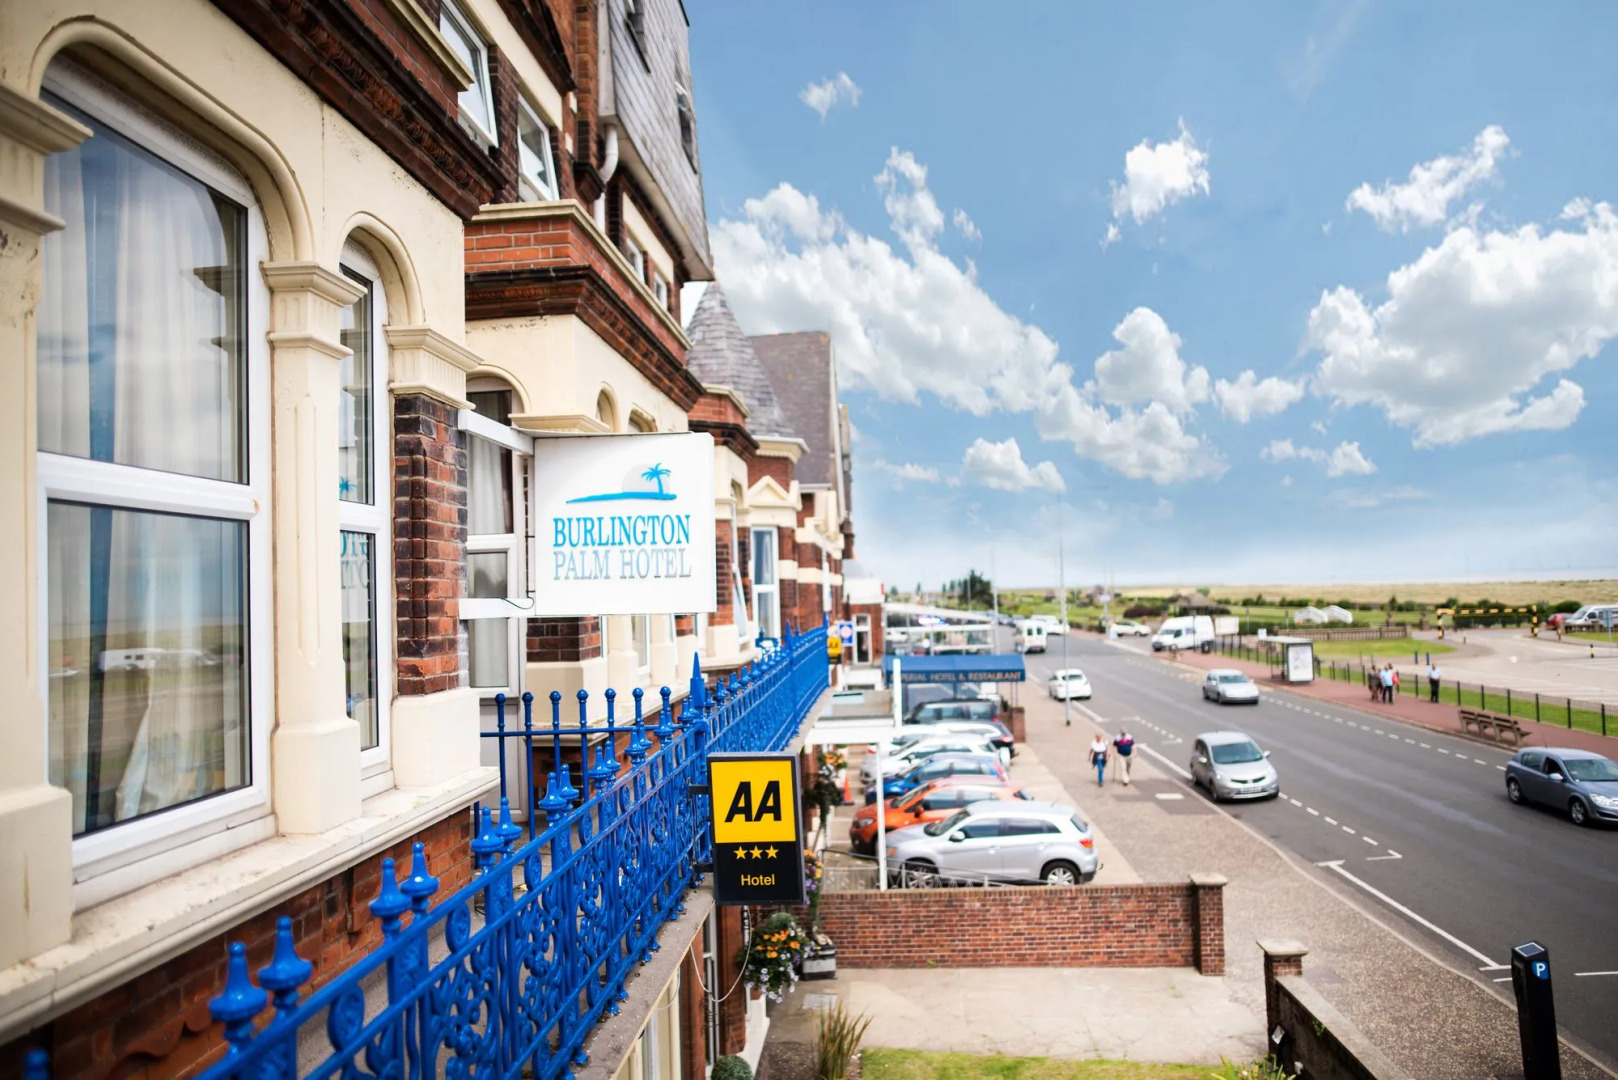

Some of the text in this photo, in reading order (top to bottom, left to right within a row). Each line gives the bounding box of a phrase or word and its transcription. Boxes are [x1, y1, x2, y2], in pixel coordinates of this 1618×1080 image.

[553, 514, 690, 547] BURLINGTON
[553, 547, 692, 580] PALM HOTEL
[889, 673, 927, 682] IPERIAL
[931, 672, 956, 682] HOTEL
[968, 671, 1021, 682] RESTAURANT
[724, 780, 782, 823] AA
[740, 874, 775, 887] Hotel
[1535, 962, 1546, 977] P
